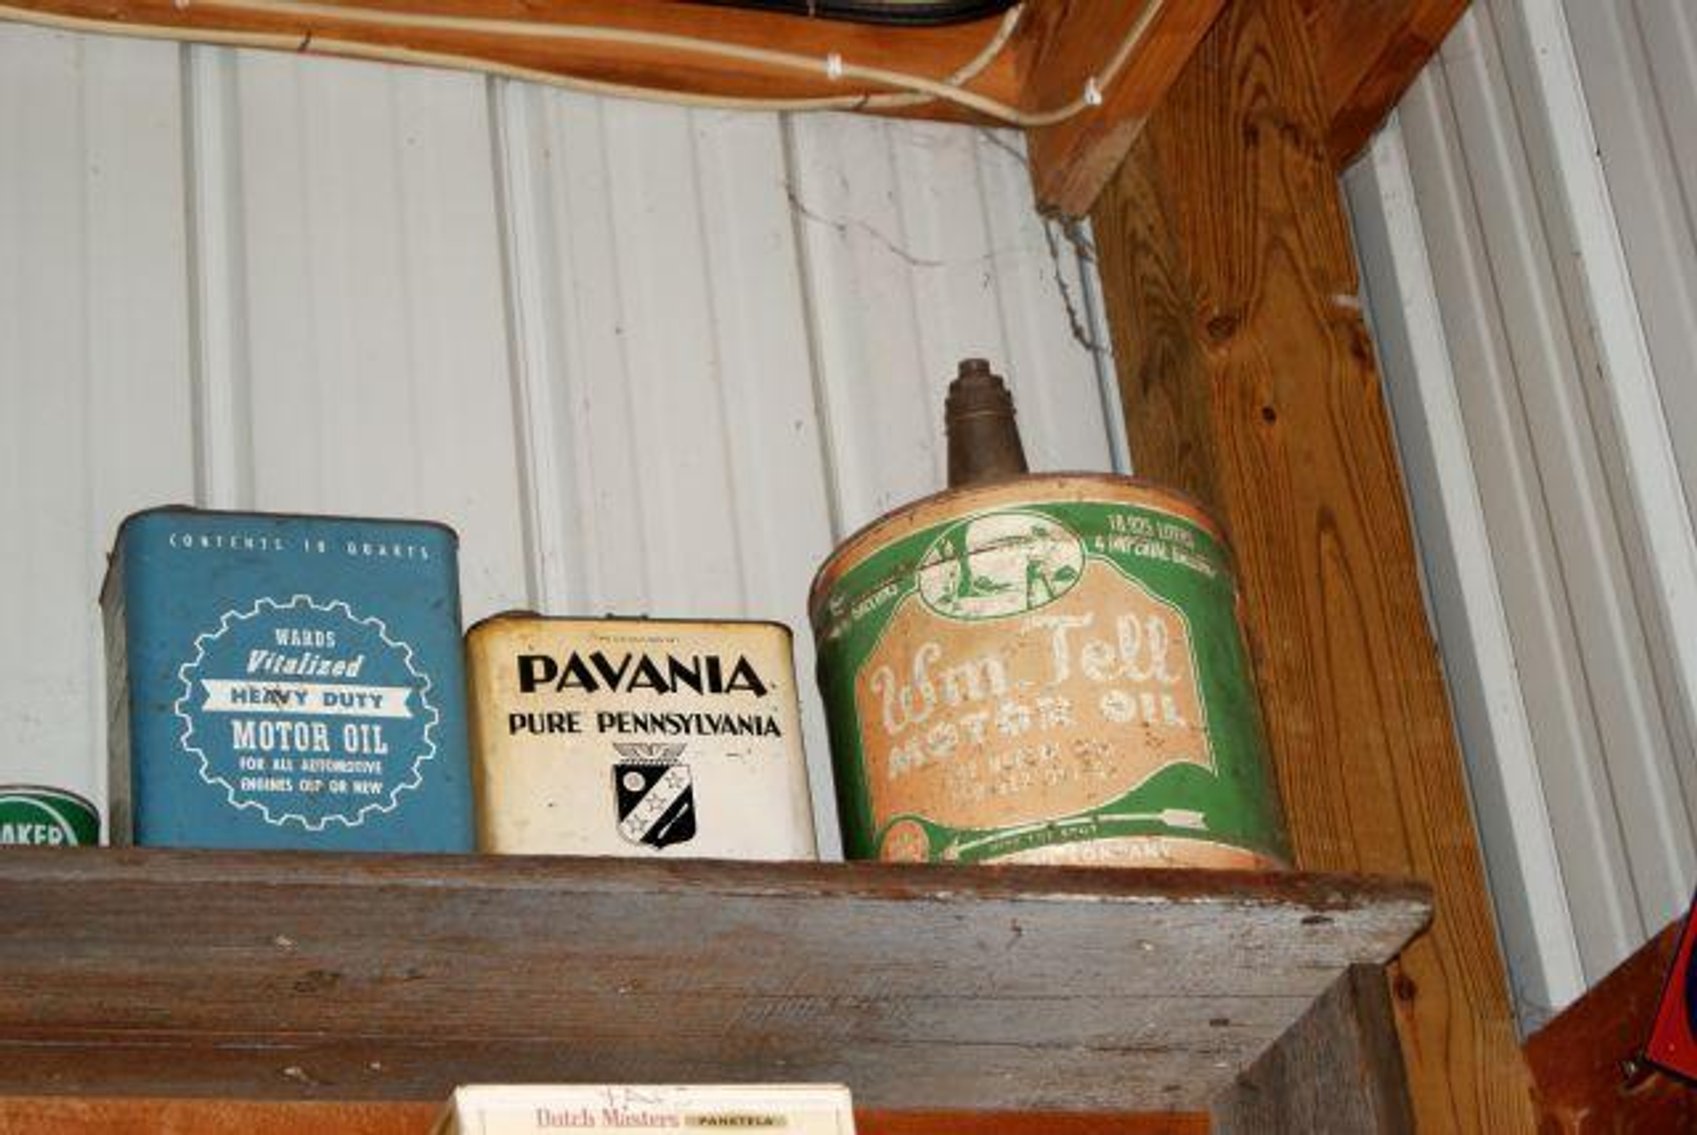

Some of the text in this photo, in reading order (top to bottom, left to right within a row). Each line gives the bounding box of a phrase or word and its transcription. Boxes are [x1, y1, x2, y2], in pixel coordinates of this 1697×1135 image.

[169, 532, 284, 551] CONTENTS
[346, 541, 429, 560] QUARTS
[275, 628, 336, 648] WARDS
[1024, 609, 1183, 686] Tell
[246, 649, 365, 678] Vitalized
[516, 651, 768, 698] PAVANIA
[230, 686, 383, 709] HEAVY DUTY
[231, 719, 389, 755] MOTOR OIL
[508, 711, 782, 738] PURE PENNSYLVANIA
[888, 697, 1073, 779] MOTOR
[1101, 690, 1187, 732] OIL
[239, 755, 383, 775] FOR ALL AUTOMOTIVE
[239, 776, 293, 793] ENGINES
[328, 780, 349, 794] OR
[352, 781, 384, 796] NEW
[535, 1107, 680, 1128] Dutch Masters
